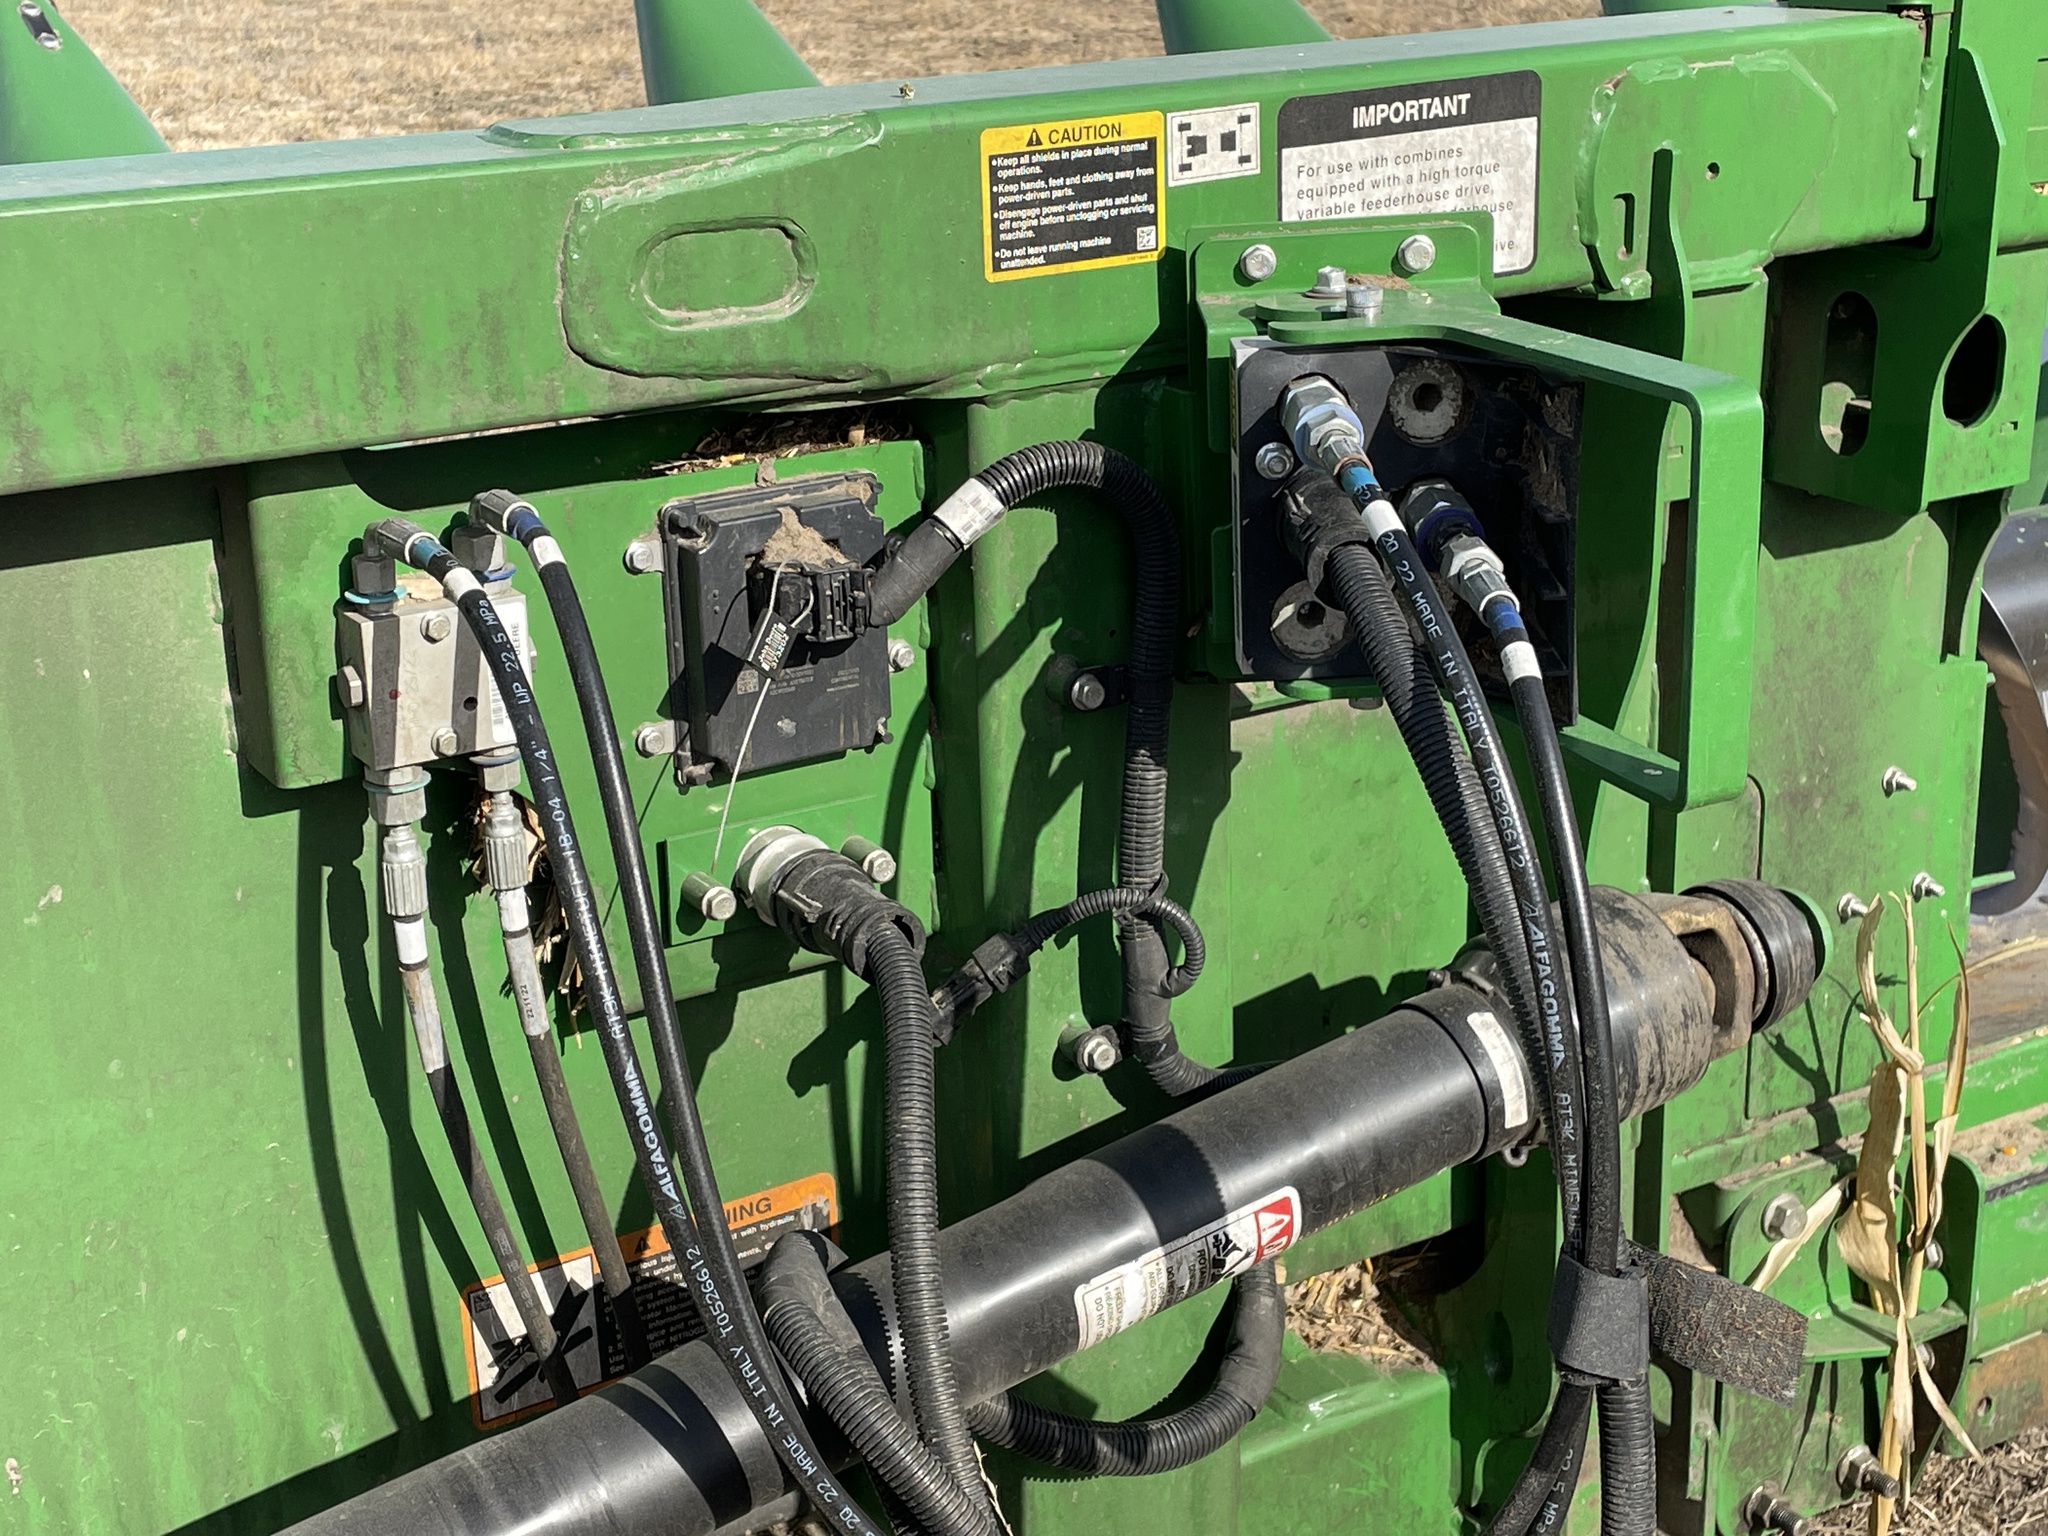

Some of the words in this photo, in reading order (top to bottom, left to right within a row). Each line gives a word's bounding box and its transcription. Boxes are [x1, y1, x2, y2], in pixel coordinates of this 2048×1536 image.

[1353, 93, 1471, 129] IMPORTANT
[1048, 122, 1122, 144] CAUTION
[998, 155, 1017, 168] Keep
[1018, 154, 1030, 165] all
[1032, 151, 1060, 164] shields
[1061, 150, 1070, 160] in
[1071, 148, 1092, 161] place
[1094, 145, 1119, 158] during
[1120, 141, 1148, 152] normal
[1298, 165, 1321, 178] For
[1328, 161, 1352, 174] use
[1358, 157, 1388, 171] with
[1394, 147, 1462, 165] combines
[997, 164, 1043, 178] operations.
[998, 182, 1019, 195] Keep
[1020, 179, 1048, 192] hands,
[1049, 176, 1064, 188] feet
[1066, 174, 1080, 186] and
[1082, 171, 1114, 186] clothing
[1115, 170, 1135, 182] away
[1136, 166, 1154, 177] from
[1297, 180, 1364, 200] equipped
[1370, 175, 1400, 190] with
[1406, 175, 1414, 184] a
[1419, 170, 1450, 188] high
[1455, 162, 1500, 179] torque
[998, 191, 1050, 206] power-driven
[1052, 188, 1075, 200] parts.
[999, 208, 1041, 222] Disengage
[1042, 202, 1092, 217] power-driven
[1094, 198, 1114, 210] parts
[1115, 196, 1130, 206] and
[1131, 192, 1148, 204] shut
[1297, 202, 1356, 220] variable
[1361, 190, 1450, 212] feederhouse
[1000, 220, 1010, 230] off
[1012, 216, 1038, 230] engine
[1040, 212, 1064, 226] before
[1066, 207, 1108, 225] unclogging
[1110, 207, 1119, 216] or
[1120, 202, 1154, 217] servicing
[1000, 230, 1036, 242] machine.
[1000, 248, 1013, 259] Do
[1014, 246, 1026, 258] not
[1028, 244, 1047, 256] leave
[1049, 241, 1078, 254] running
[1080, 236, 1112, 250] machine
[1000, 256, 1046, 269] unattended.
[478, 599, 501, 627] MPa
[491, 632, 520, 672] 22.5
[512, 682, 532, 706] WP
[532, 739, 556, 783] 1/4"
[1396, 560, 1416, 583] 22
[1412, 591, 1443, 639] MADE
[1438, 650, 1458, 678] IN
[1454, 688, 1488, 749] ITALY
[1482, 762, 1526, 869] T0526612
[1528, 926, 1566, 1073] ALFAGOMMA
[624, 1055, 680, 1203] ALFAGOMMA
[740, 1226, 757, 1238] with
[760, 1214, 795, 1232] hydraulic
[654, 1264, 676, 1276] under
[687, 1245, 734, 1338] T0526612
[1094, 1297, 1104, 1312] DO
[1096, 1313, 1104, 1330] NOT
[730, 1345, 766, 1398] ITALY
[764, 1402, 784, 1428] IN
[783, 1434, 818, 1476] MADE
[816, 1478, 839, 1503] 22
[1536, 1501, 1559, 1534] MPa
